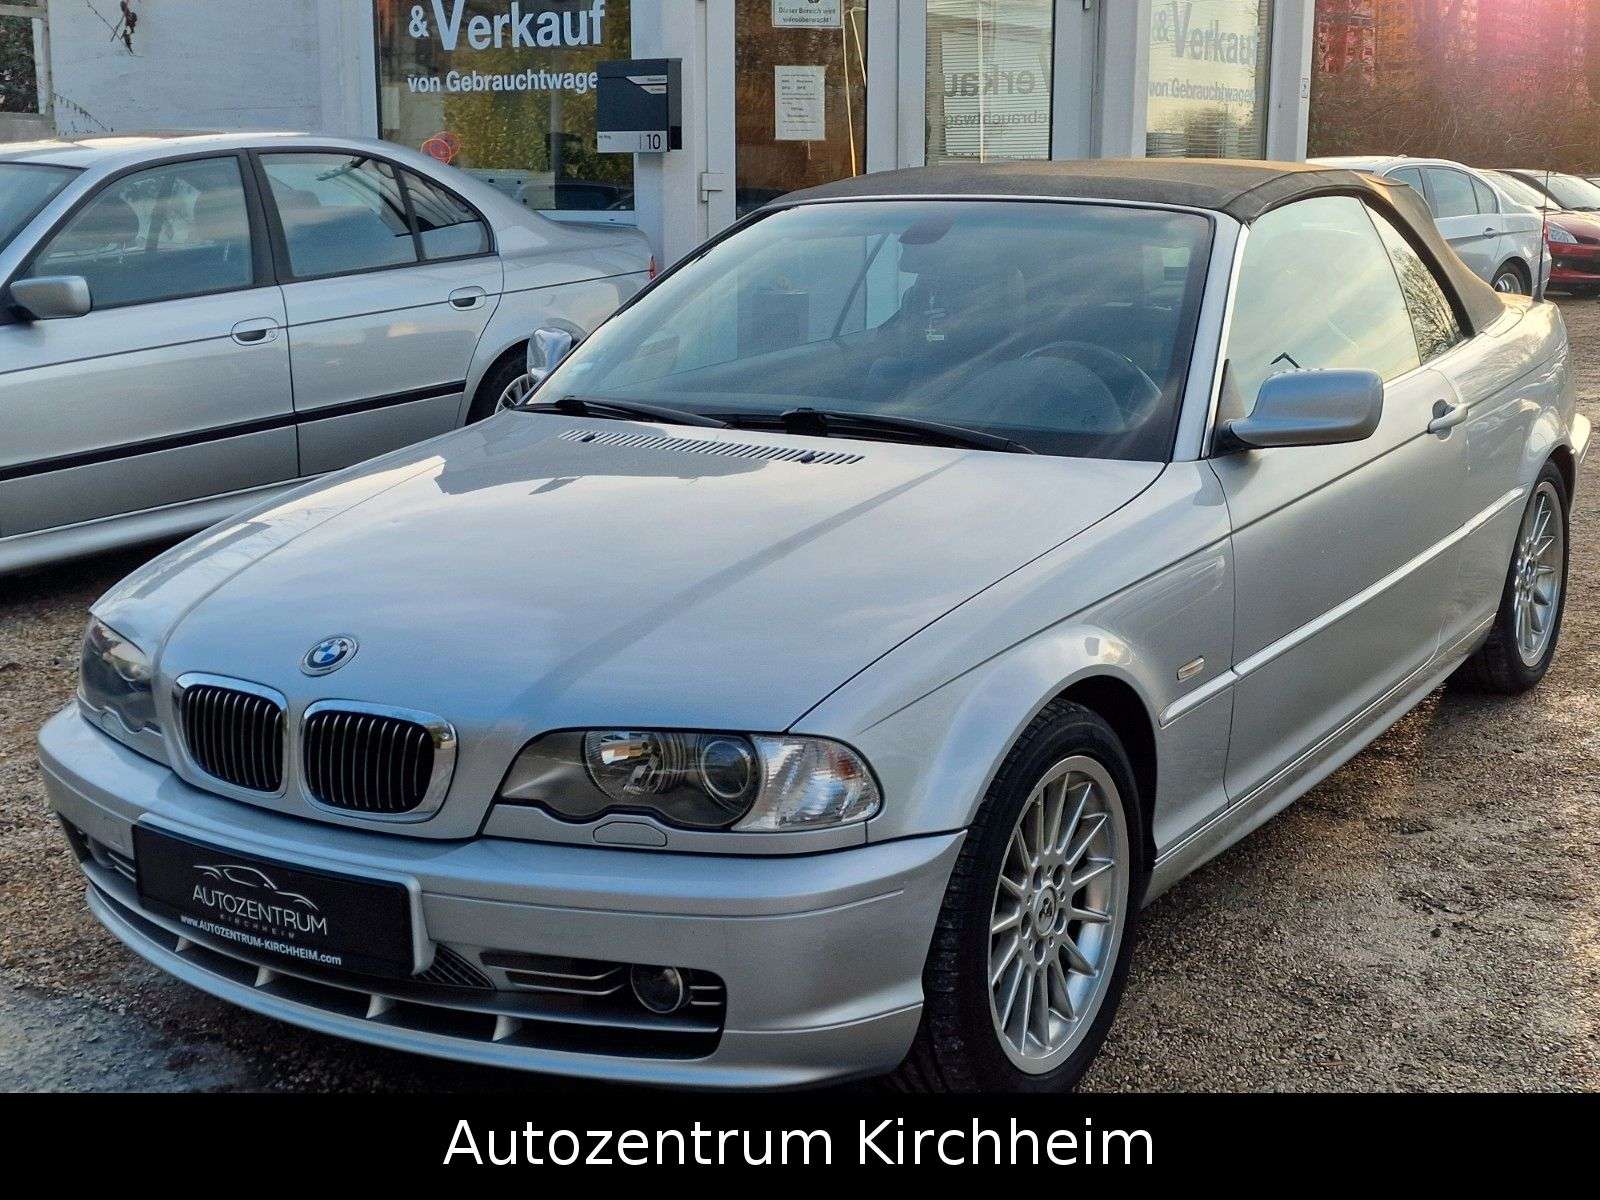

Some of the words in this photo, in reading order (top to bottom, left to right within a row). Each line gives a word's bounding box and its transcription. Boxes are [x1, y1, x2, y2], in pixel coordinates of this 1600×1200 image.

[408, 5, 429, 39] &
[431, 0, 606, 51] Verkauf
[407, 75, 441, 93] von
[446, 69, 599, 95] Gebrauchtwage
[646, 134, 661, 150] 10
[192, 884, 328, 936] AUTOZENTRUM
[180, 914, 343, 966] www.AUTOZENTRUM-KIRCHHEIM.com
